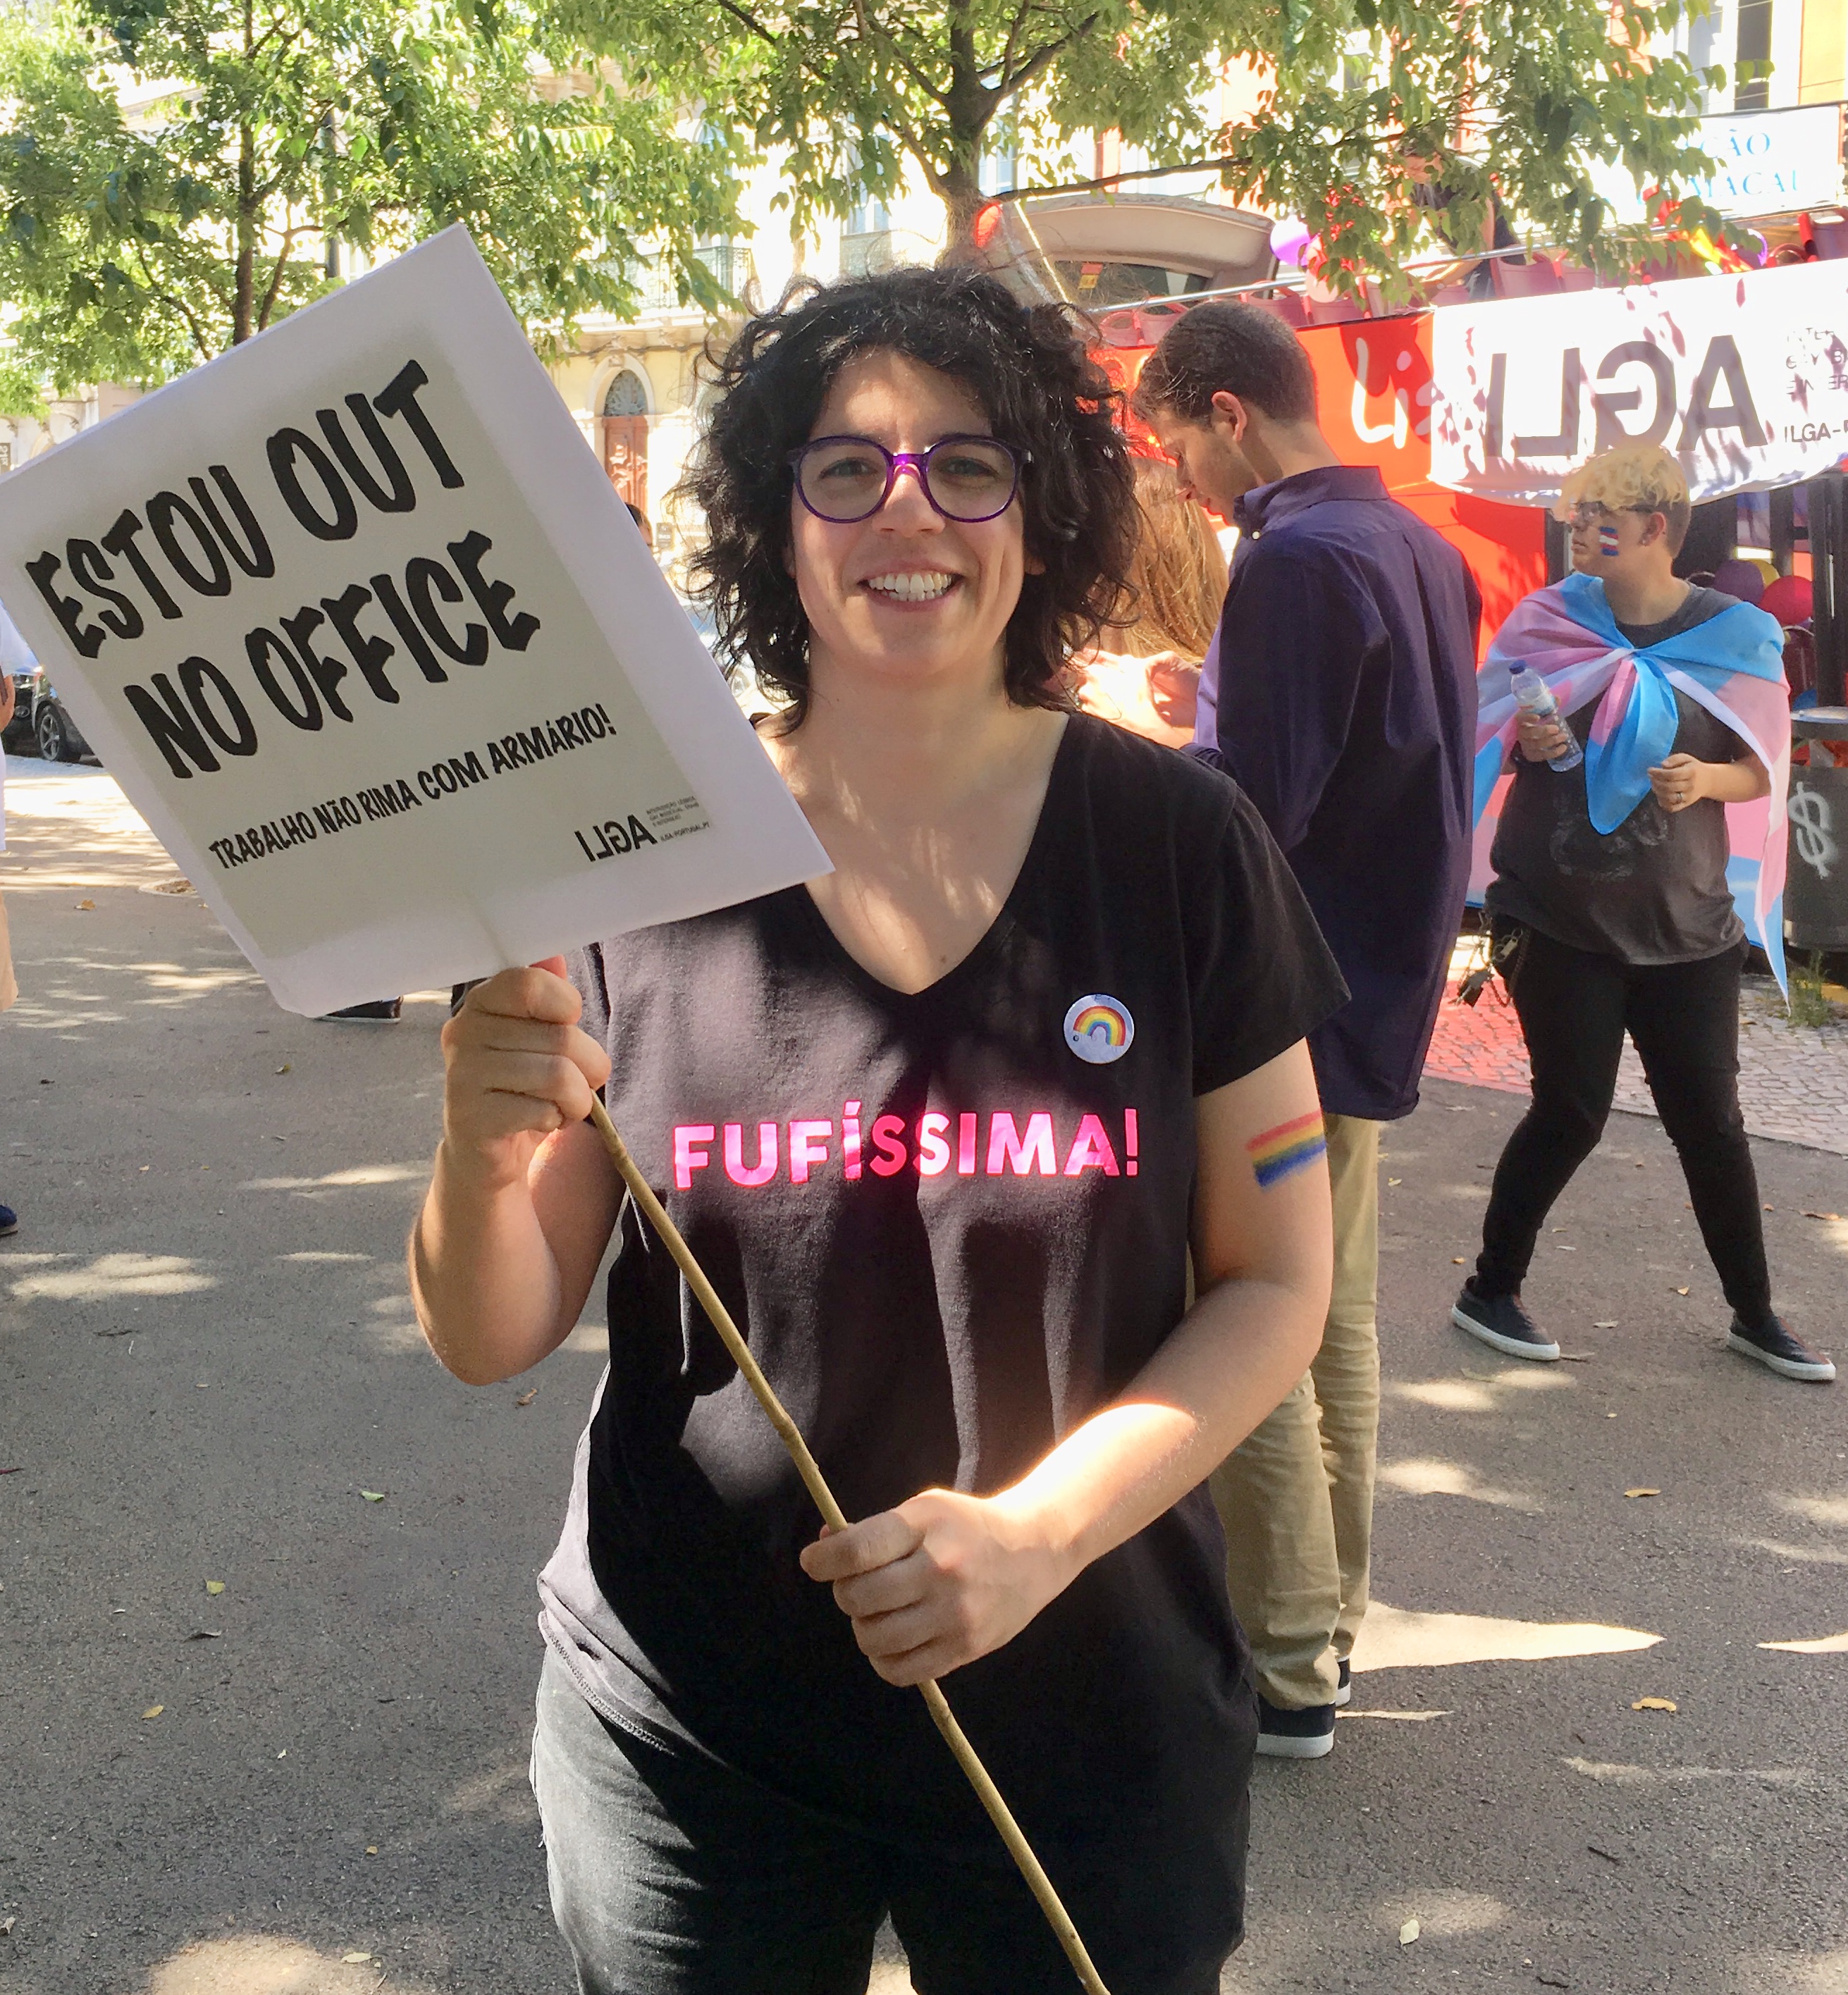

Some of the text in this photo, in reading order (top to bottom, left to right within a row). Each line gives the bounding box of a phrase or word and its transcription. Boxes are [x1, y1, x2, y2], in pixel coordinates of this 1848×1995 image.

[25, 359, 465, 660] ESTOU OUT
[123, 530, 541, 779] NO OFFICE
[208, 703, 617, 869] TRABALHO NÃO RIMA COM ARMÁRIO!
[674, 1099, 1139, 1190] FUFÍSSIMA!
